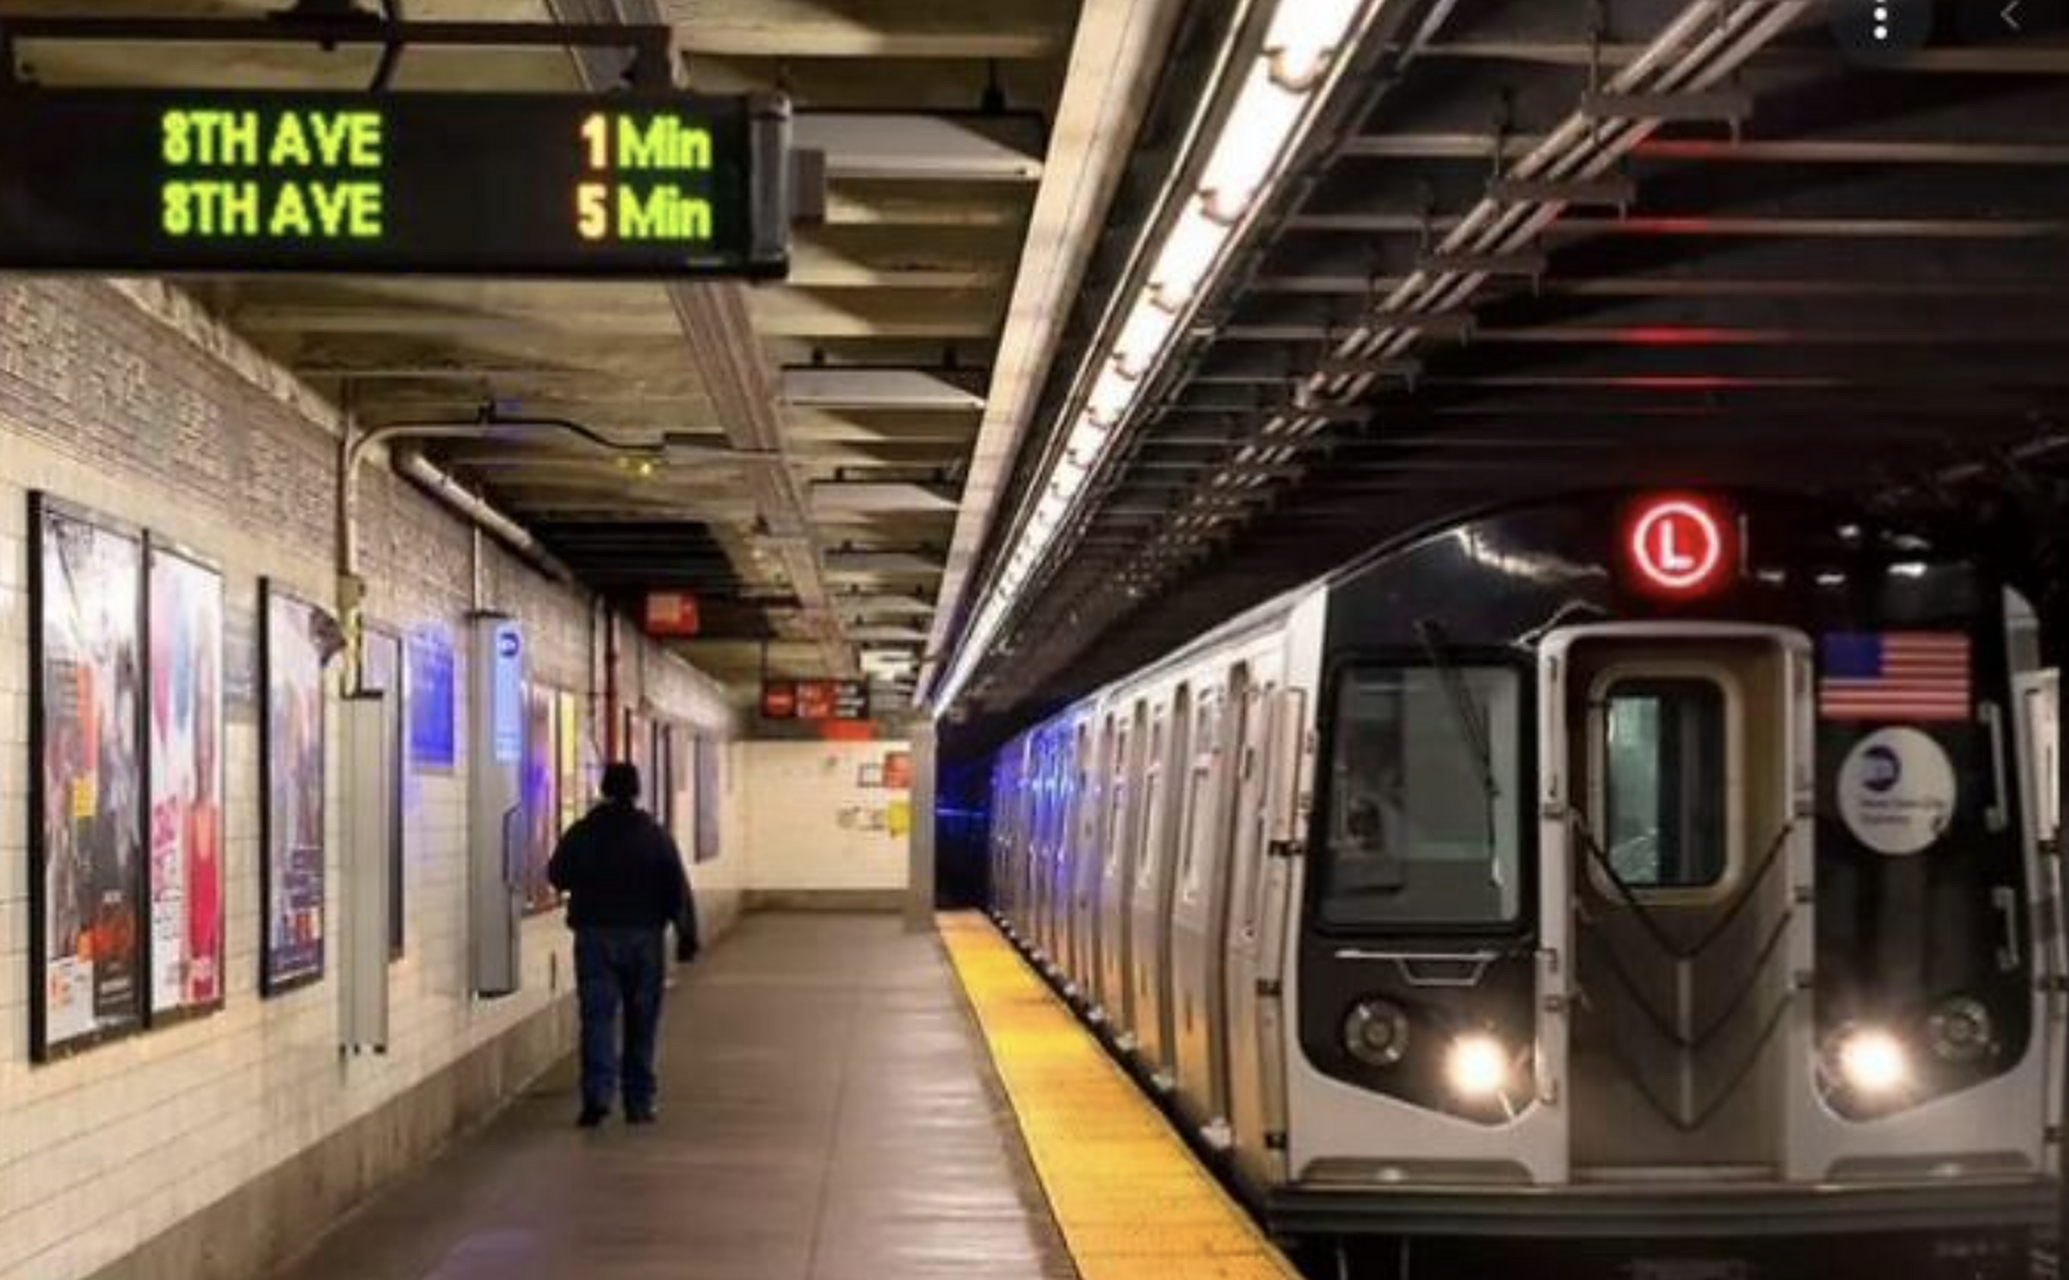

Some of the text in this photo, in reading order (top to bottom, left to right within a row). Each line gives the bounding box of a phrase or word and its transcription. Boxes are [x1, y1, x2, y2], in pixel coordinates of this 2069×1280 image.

[161, 110, 712, 169] 8TH AVE 1 Min
[161, 180, 712, 240] 8TH AVE 5 Min
[1660, 519, 1695, 571] L
